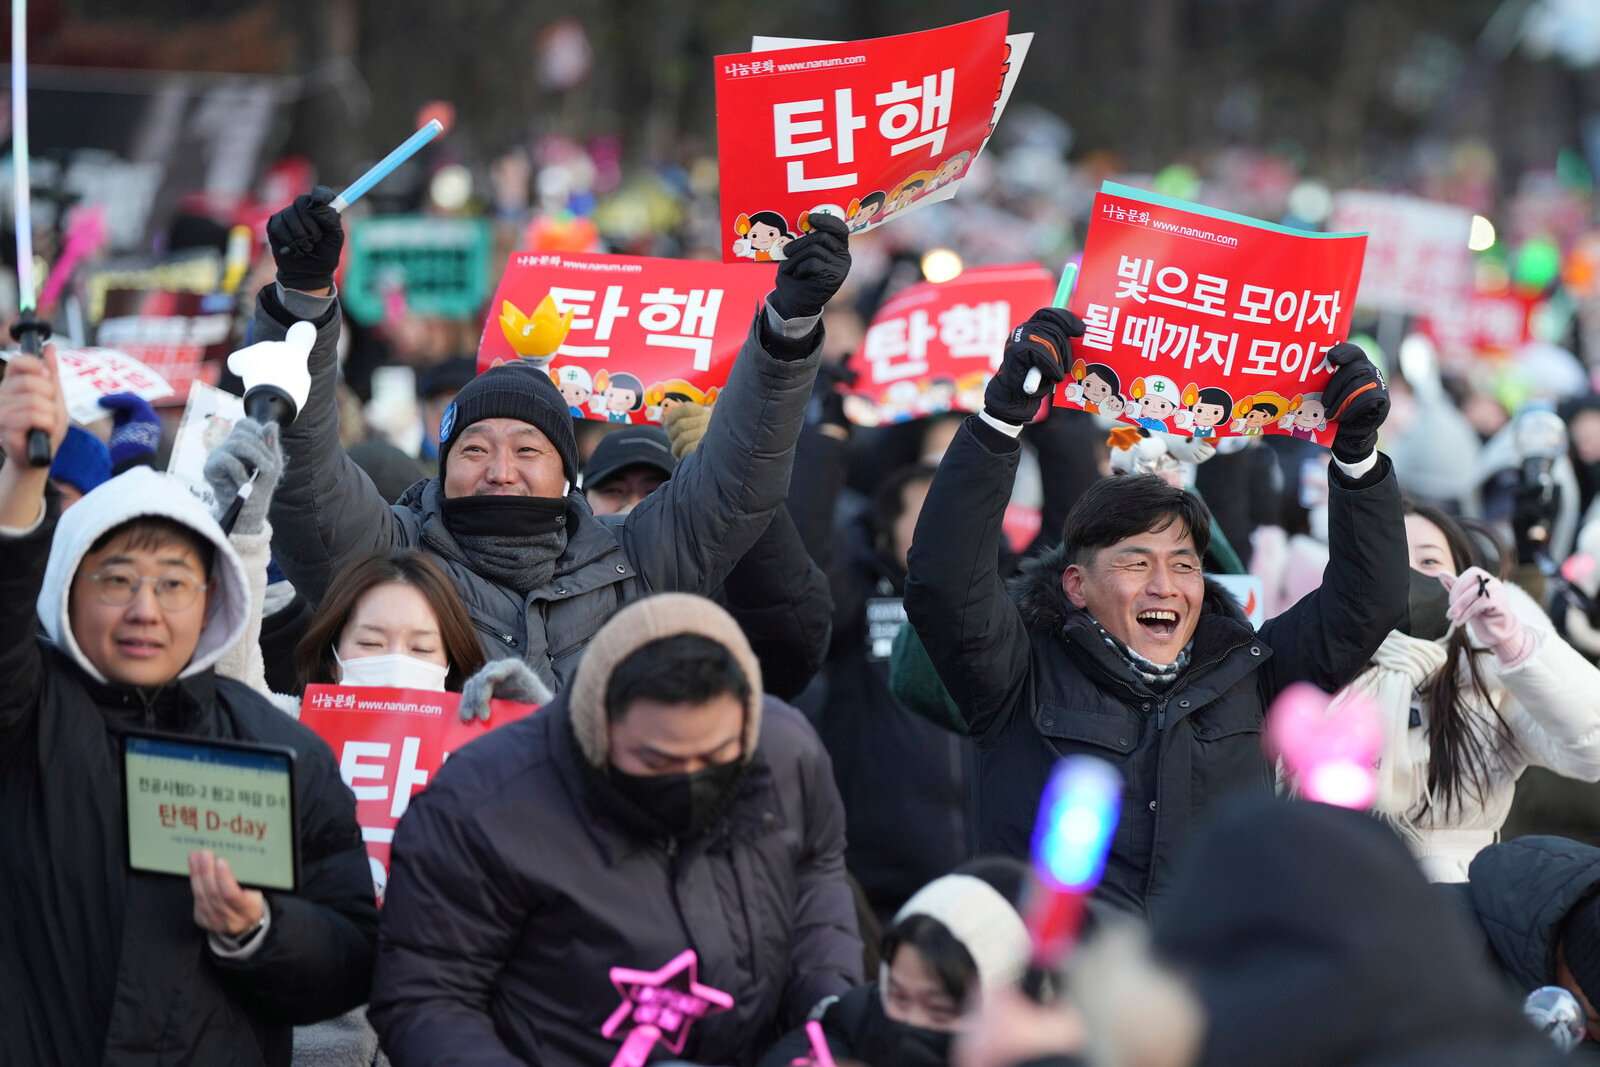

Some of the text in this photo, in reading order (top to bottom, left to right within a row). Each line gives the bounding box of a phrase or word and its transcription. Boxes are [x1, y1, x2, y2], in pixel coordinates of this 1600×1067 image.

[725, 55, 866, 76] 나눔문화 www.nanum.com
[773, 68, 955, 193] 탄핵
[1103, 204, 1238, 246] 나눔문화 www.nanum.com
[563, 260, 643, 273] www.nanum.com
[1115, 255, 1342, 334] 빛으로 모이자
[548, 285, 725, 372] 탄핵
[864, 300, 1010, 384] 탄핵
[1082, 303, 1119, 352] 될
[1121, 315, 1239, 377] 때까지
[312, 693, 443, 715] 나눔문화 www.nanum.com
[158, 803, 268, 841] 탄핵 D-day
